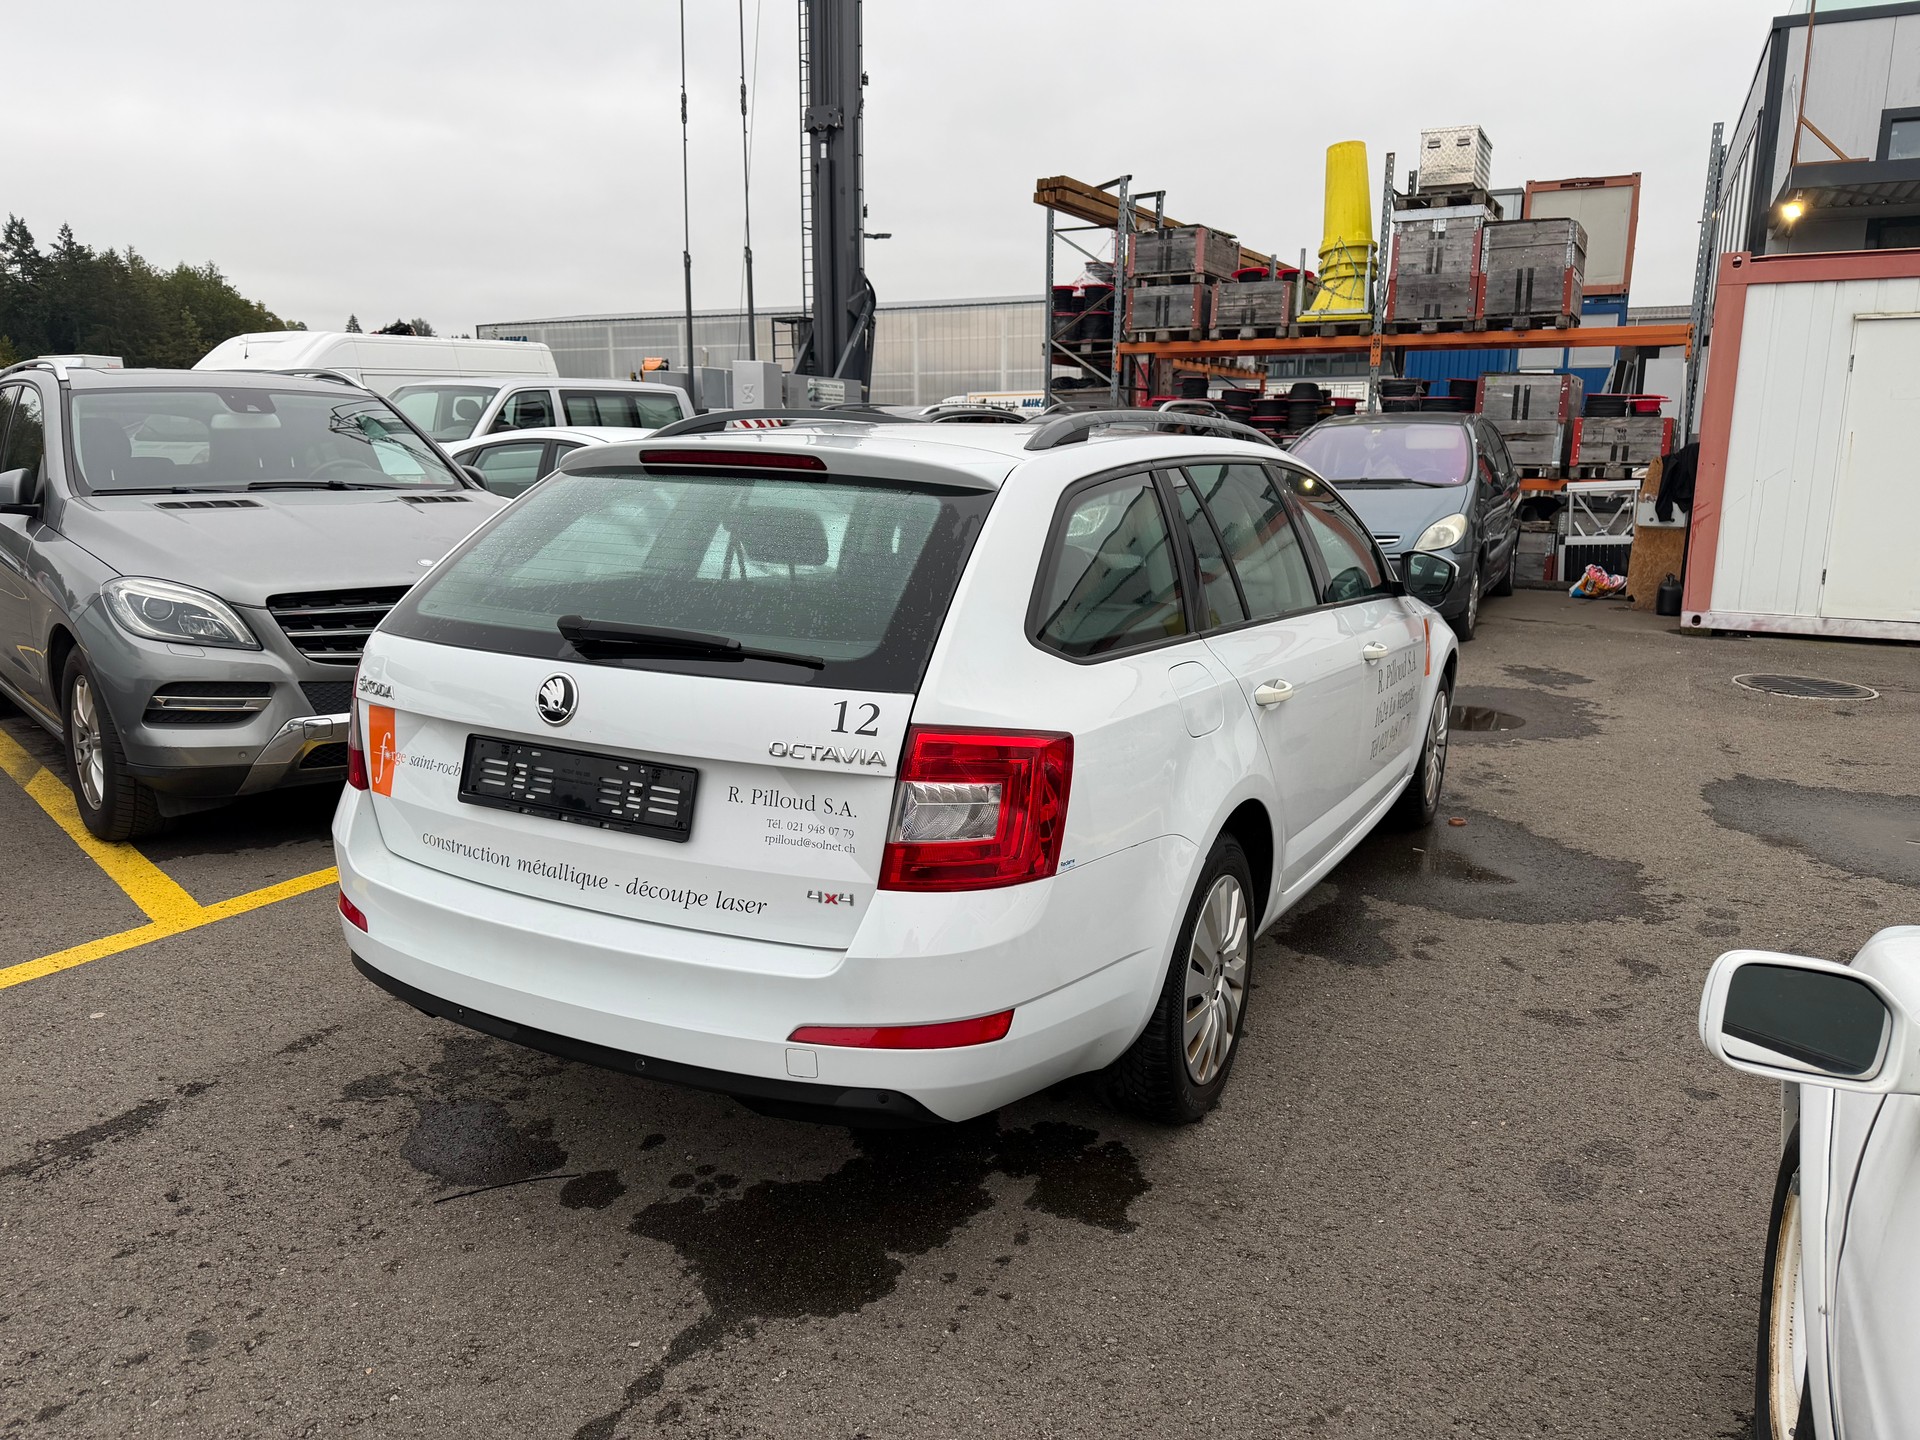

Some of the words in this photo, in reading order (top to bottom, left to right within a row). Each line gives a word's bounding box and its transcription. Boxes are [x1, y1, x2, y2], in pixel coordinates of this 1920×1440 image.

[1386, 652, 1407, 690] Pilloud
[831, 700, 881, 737] 12
[409, 755, 462, 777] saint-roch
[768, 740, 888, 767] OCTAVIA
[727, 785, 744, 804] R.
[750, 788, 816, 812] Pilloud
[823, 797, 857, 818] S.A.
[766, 818, 784, 830] Tél.
[786, 821, 803, 832] 021
[807, 823, 826, 834] 948
[828, 826, 840, 837] 07
[843, 829, 855, 839] 79
[764, 834, 856, 854] rpilloud@solnet.ch
[422, 832, 511, 868] construction
[517, 859, 609, 890] métallique
[626, 877, 709, 910] découpe
[715, 890, 768, 915] laser
[807, 890, 854, 907] 4x4
